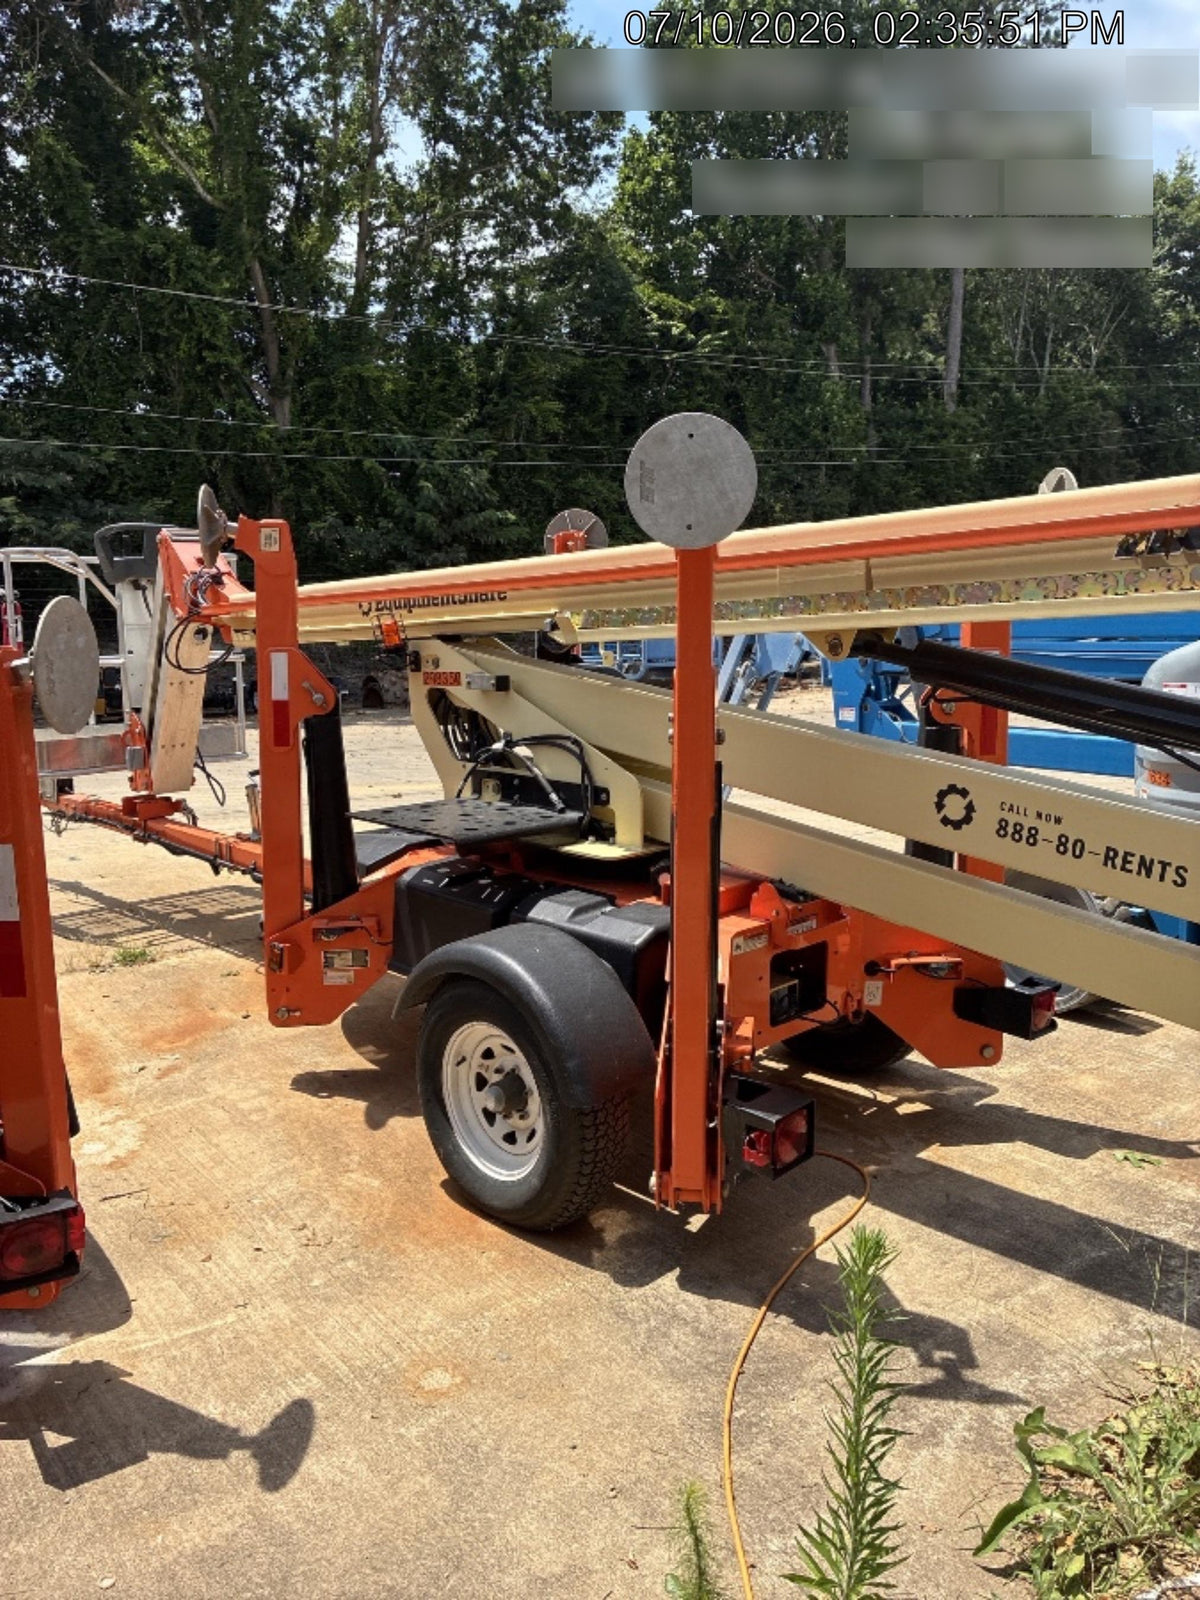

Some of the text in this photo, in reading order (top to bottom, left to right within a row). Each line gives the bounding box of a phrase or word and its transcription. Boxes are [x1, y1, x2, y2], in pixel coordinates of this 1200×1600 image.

[1000, 801, 1063, 825] CALL NOW
[995, 817, 1188, 888] 888-80-RENTS
